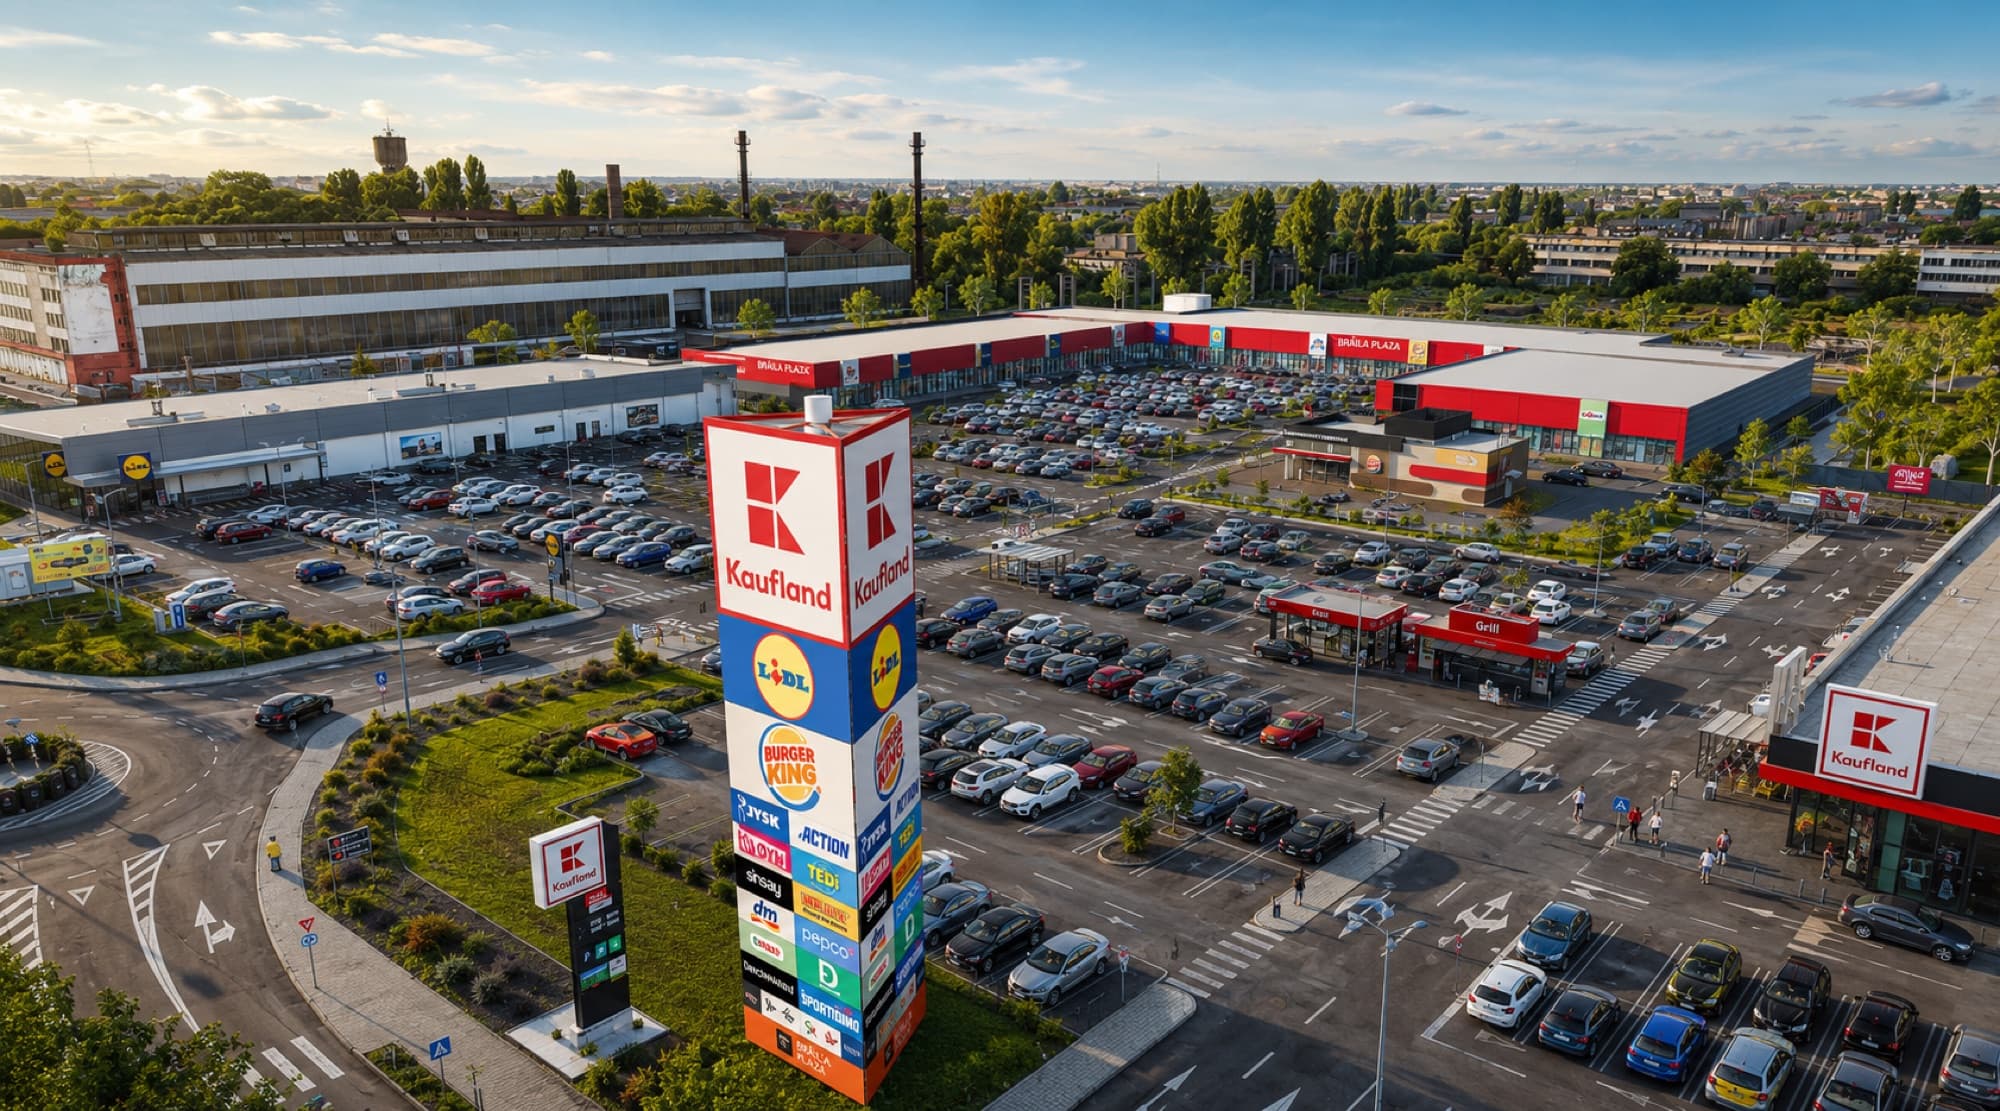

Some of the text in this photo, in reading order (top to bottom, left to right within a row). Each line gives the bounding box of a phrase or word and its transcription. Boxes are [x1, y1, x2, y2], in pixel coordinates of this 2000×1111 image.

[726, 557, 832, 611] Kaufland
[854, 546, 909, 609] Kaufland
[764, 745, 815, 763] BURGER
[1831, 750, 1909, 778] Kaufland
[767, 763, 817, 786] KING
[746, 805, 780, 830] JYSK
[801, 826, 850, 860] ACTION
[553, 867, 597, 893] Kaufland
[753, 900, 777, 923] dm
[802, 927, 849, 960] pepco
